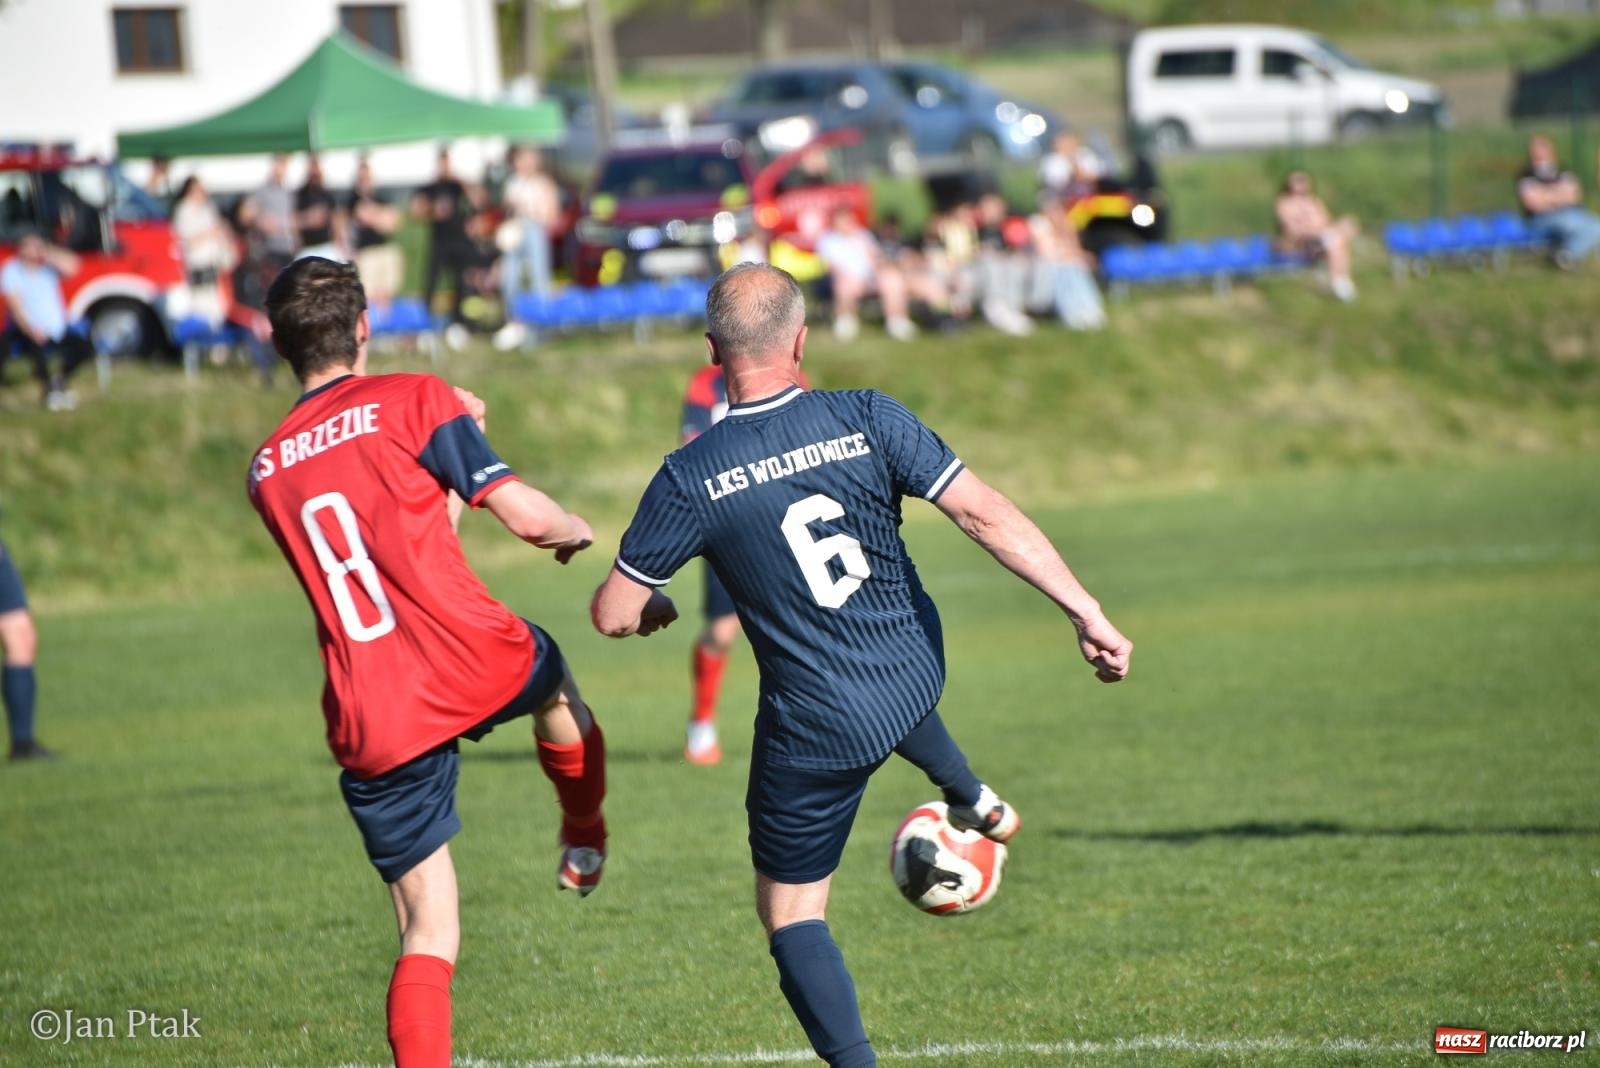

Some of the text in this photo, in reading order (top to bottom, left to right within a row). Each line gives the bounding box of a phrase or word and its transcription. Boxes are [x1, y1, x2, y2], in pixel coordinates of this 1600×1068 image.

[279, 403, 381, 469] BRZEZIE
[704, 432, 871, 501] LKS WOJNOWICE
[301, 491, 397, 642] 8
[780, 493, 871, 609] 6
